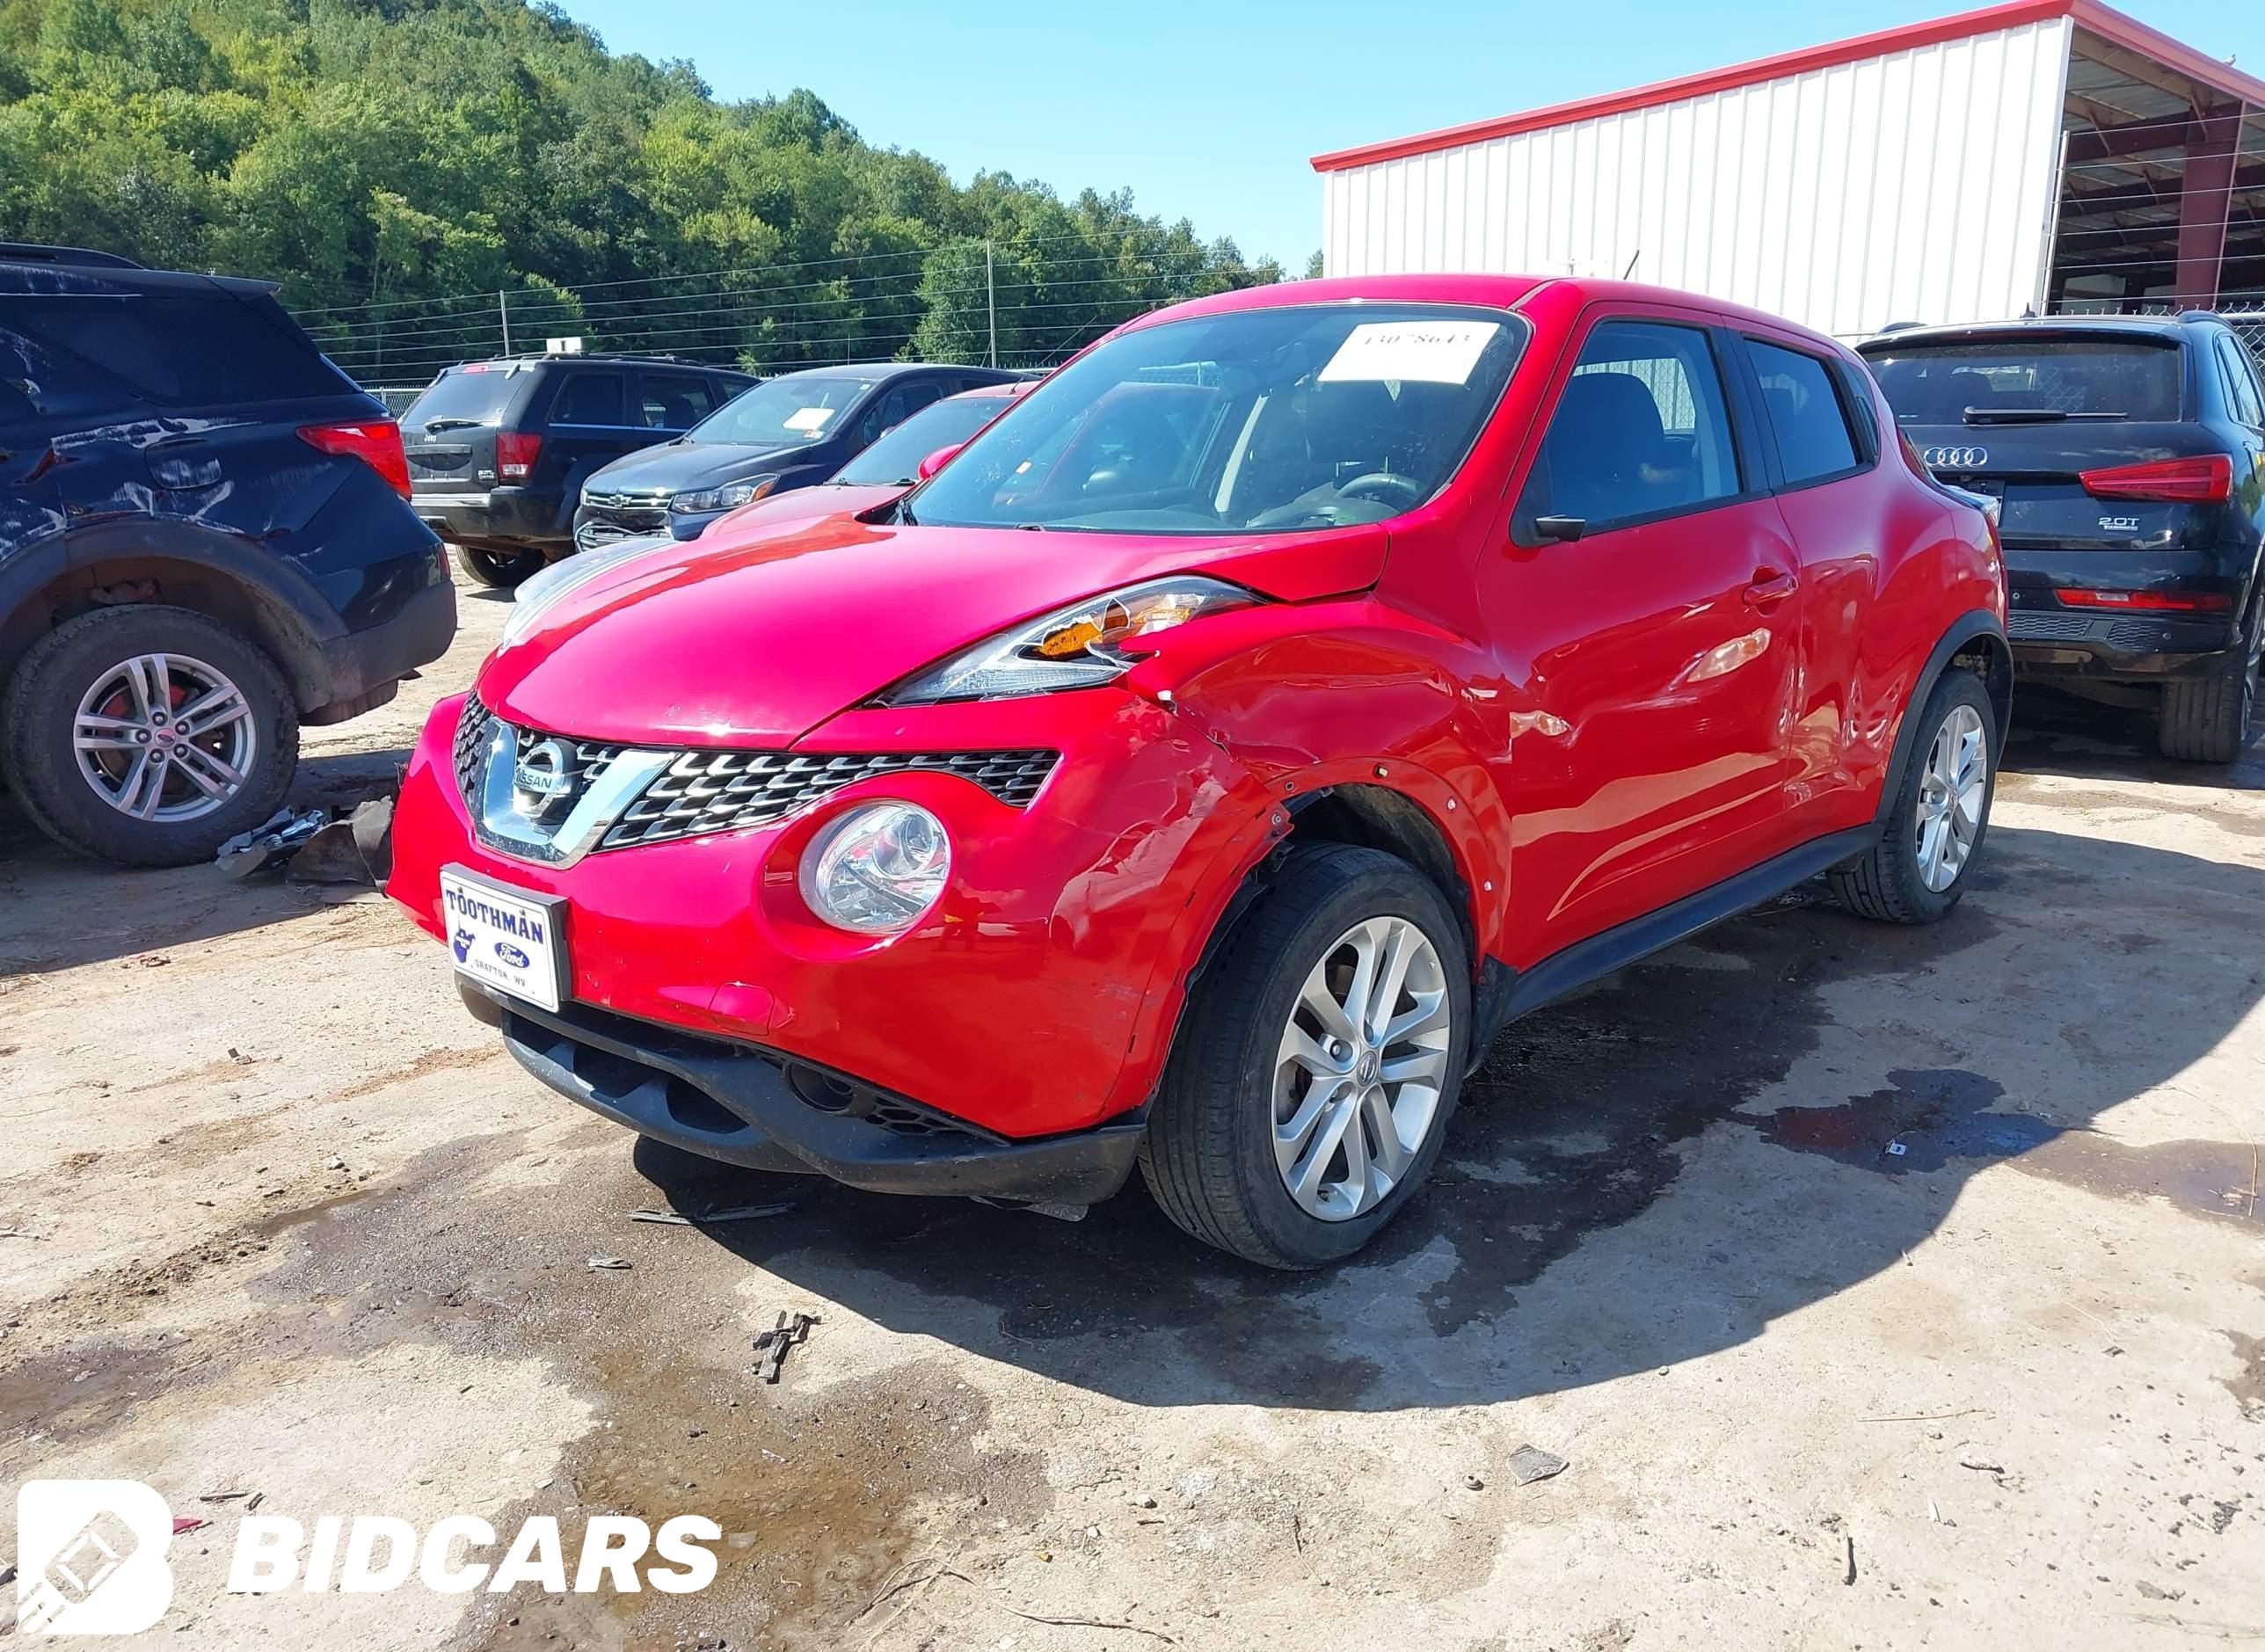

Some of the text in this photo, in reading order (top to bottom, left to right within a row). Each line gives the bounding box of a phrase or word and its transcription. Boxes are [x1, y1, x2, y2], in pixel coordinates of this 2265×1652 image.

[515, 766, 553, 789] NISSAN
[446, 889, 543, 944] TOOTHMAN
[499, 944, 525, 967] Ford
[513, 975, 526, 986] WV
